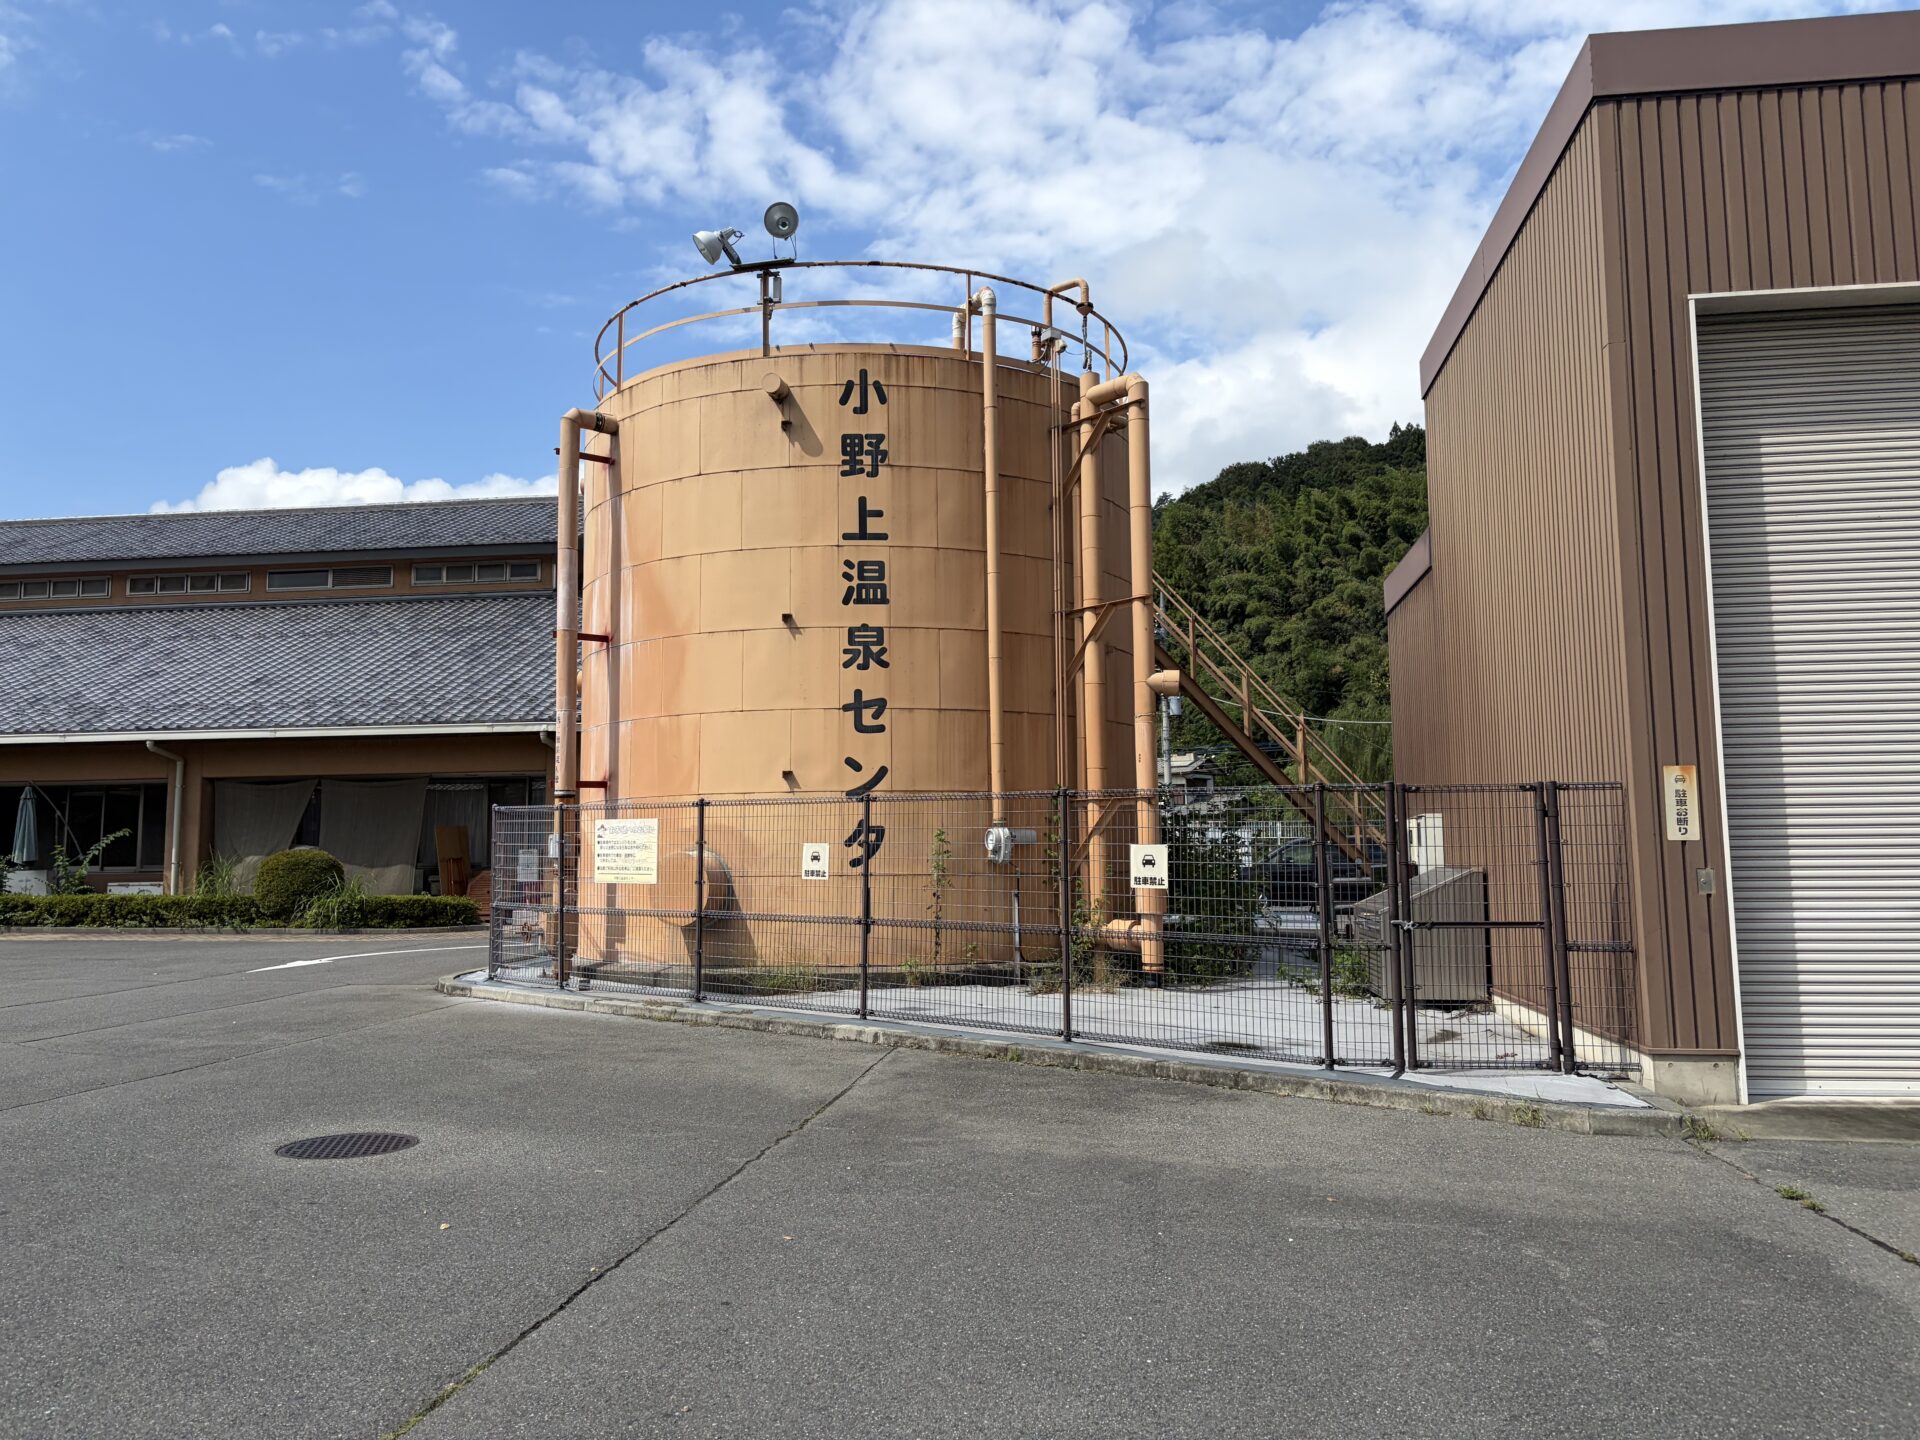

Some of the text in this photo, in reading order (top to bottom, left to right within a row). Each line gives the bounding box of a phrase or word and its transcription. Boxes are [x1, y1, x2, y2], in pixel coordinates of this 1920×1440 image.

[1674, 788, 1689, 836] 駐車お断り
[804, 869, 827, 878] 駐車禁止
[1133, 876, 1165, 886] 駐車禁止
